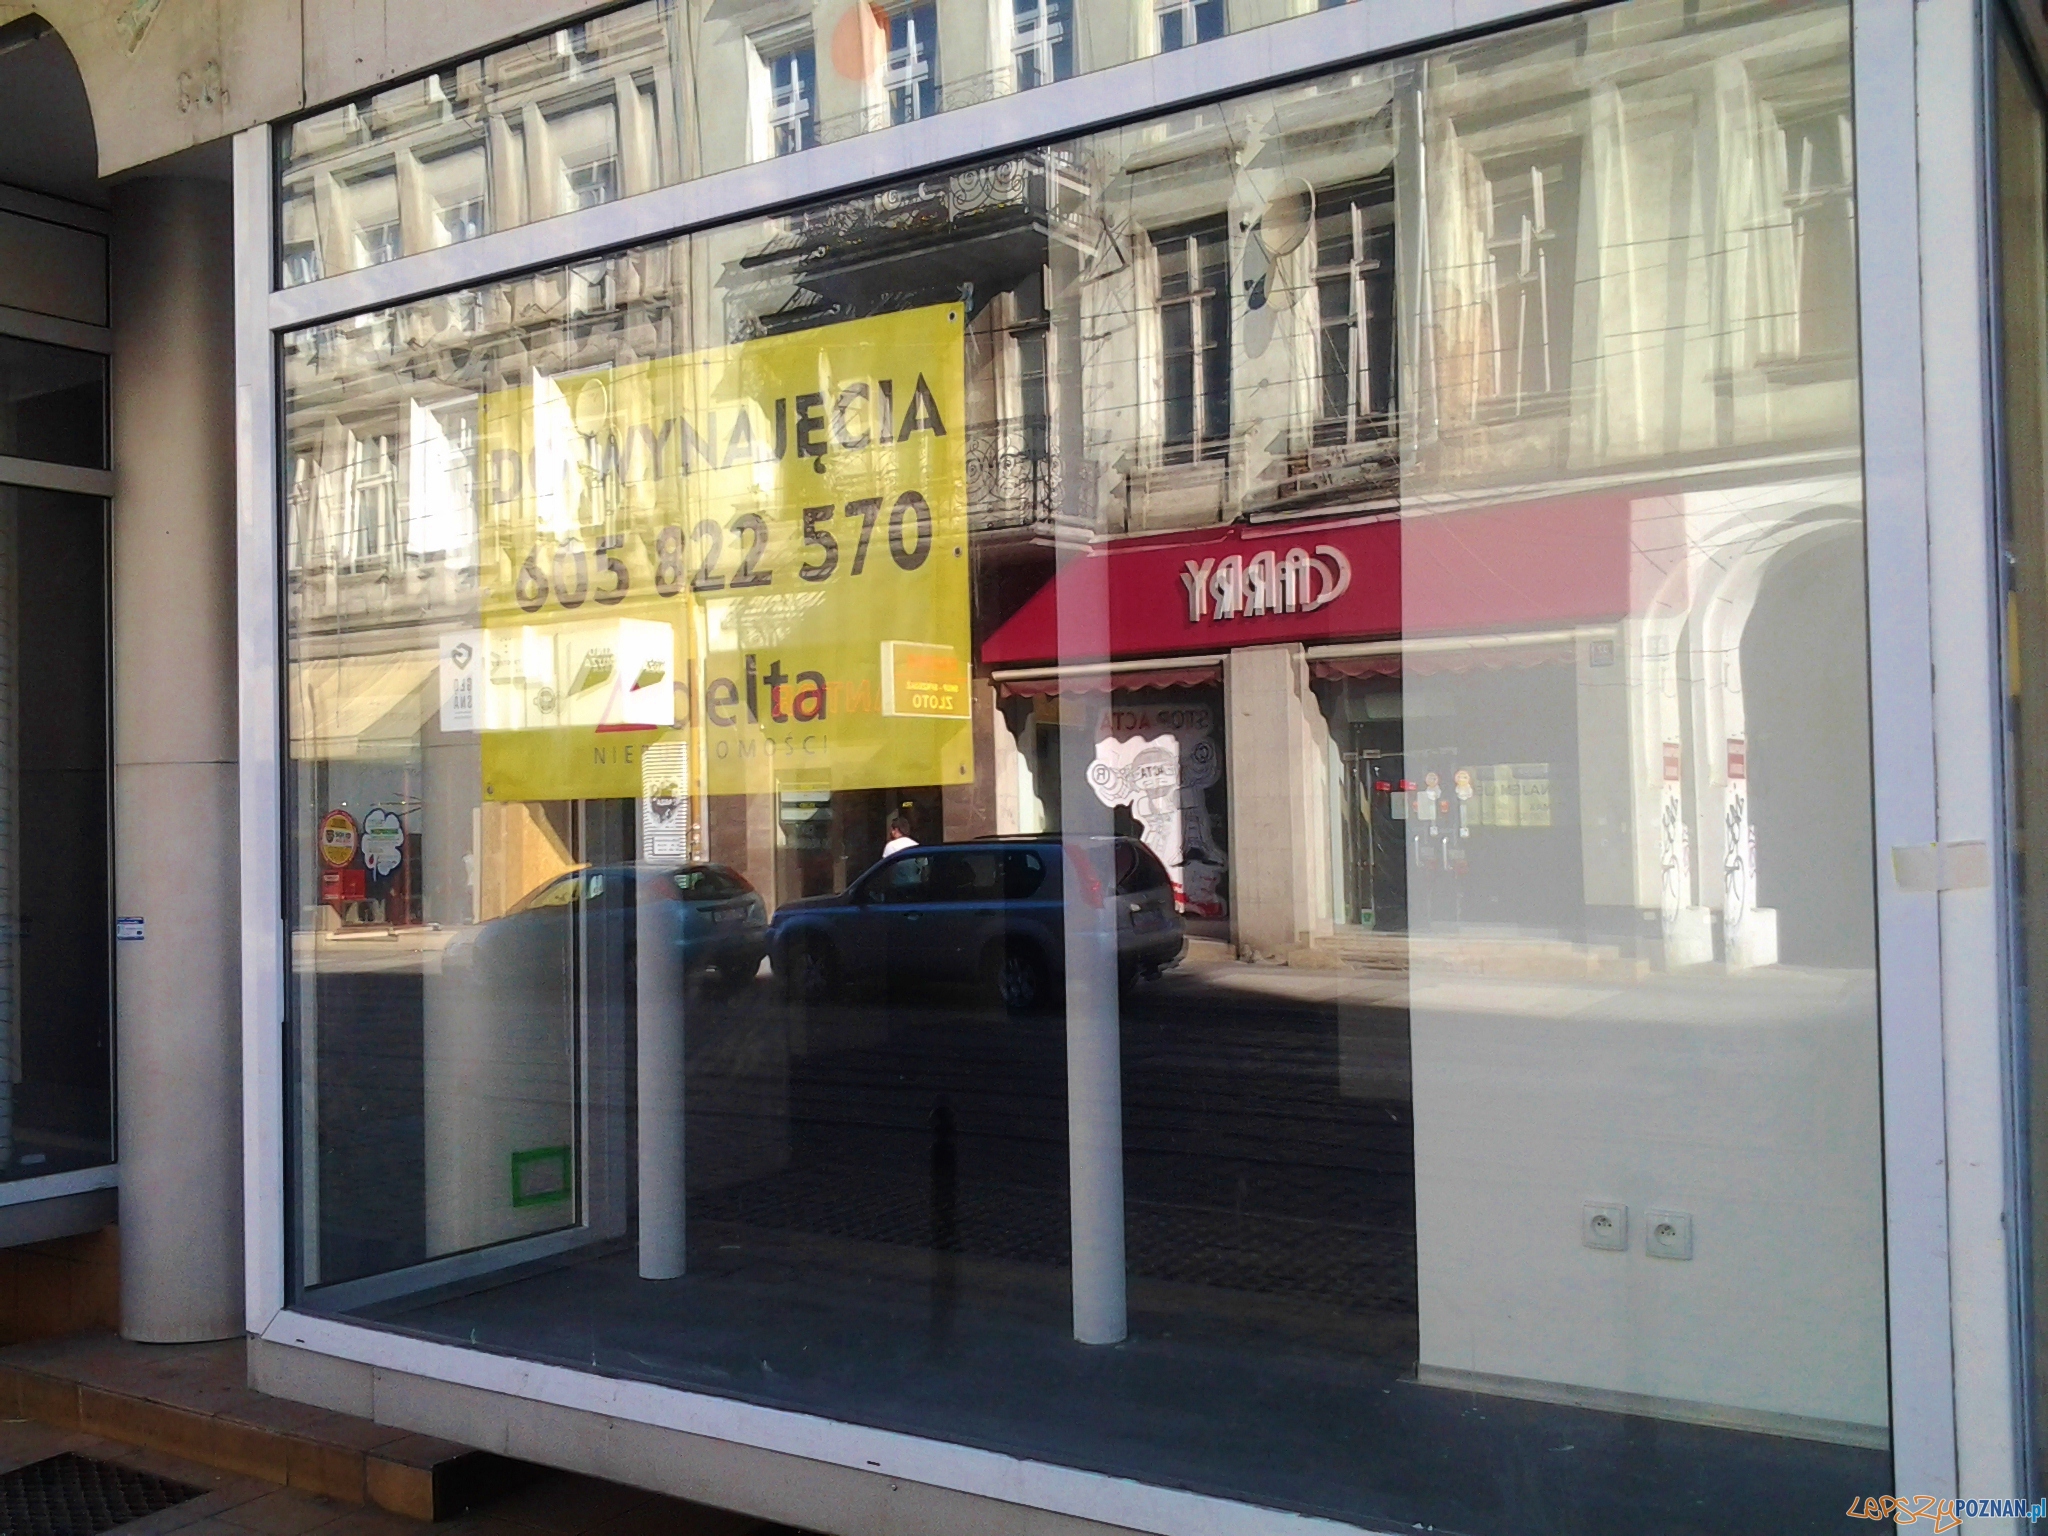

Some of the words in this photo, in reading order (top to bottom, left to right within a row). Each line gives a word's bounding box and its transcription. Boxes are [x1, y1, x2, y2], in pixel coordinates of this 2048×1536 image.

[515, 534, 630, 613] 605
[655, 513, 772, 598] 822
[798, 490, 933, 582] 570
